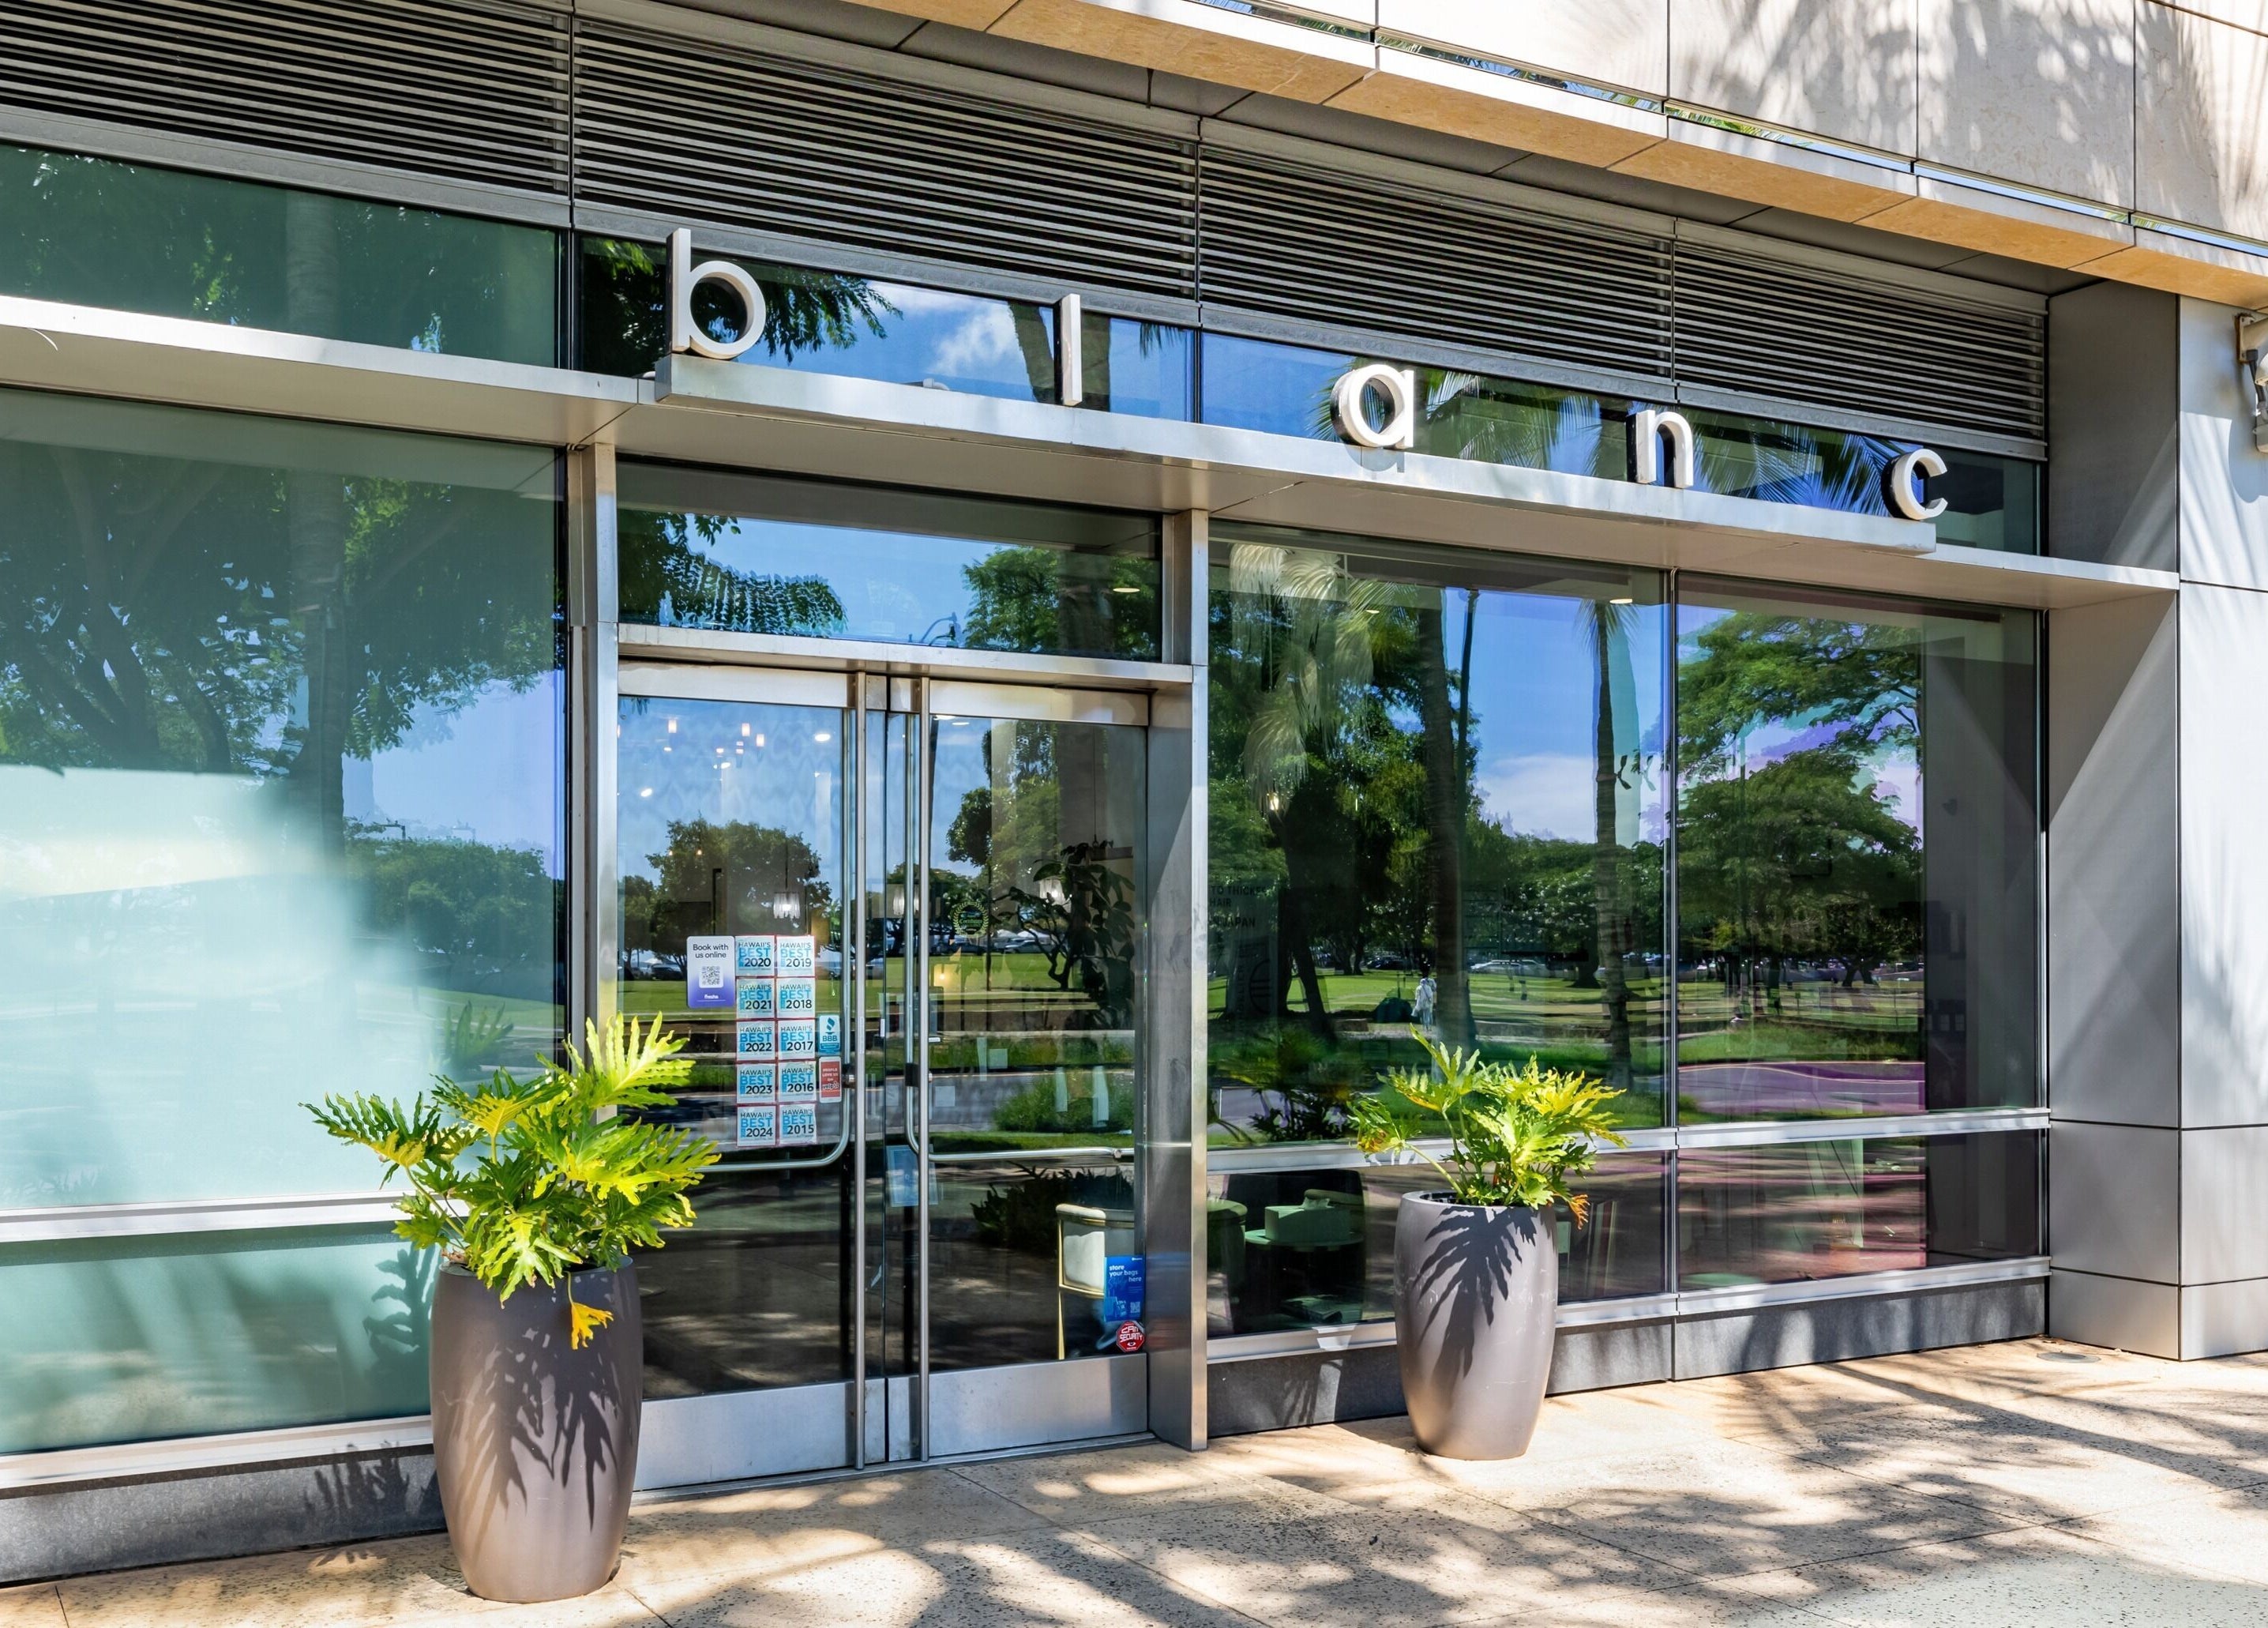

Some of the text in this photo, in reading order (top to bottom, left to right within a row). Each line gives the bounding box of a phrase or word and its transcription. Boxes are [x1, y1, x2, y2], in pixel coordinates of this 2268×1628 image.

[739, 948, 771, 957] BEST
[781, 948, 811, 957] BEST
[745, 958, 772, 967] 2020
[787, 958, 812, 967] 2019
[740, 990, 772, 999] BEST
[780, 990, 811, 999] BEST
[745, 1000, 772, 1010] 2021
[786, 999, 812, 1009] 2018
[740, 1032, 772, 1042] BEST
[781, 1032, 813, 1041] BEST
[745, 1043, 772, 1052] 2022
[787, 1041, 813, 1051] 2017
[740, 1075, 772, 1085] BEST
[782, 1073, 813, 1083] BEST
[745, 1085, 773, 1095] 2023
[787, 1083, 814, 1092] 2016
[741, 1118, 773, 1127] BEST
[783, 1115, 813, 1125] BEST
[746, 1128, 773, 1137] 2024
[787, 1124, 814, 1134] 2015
